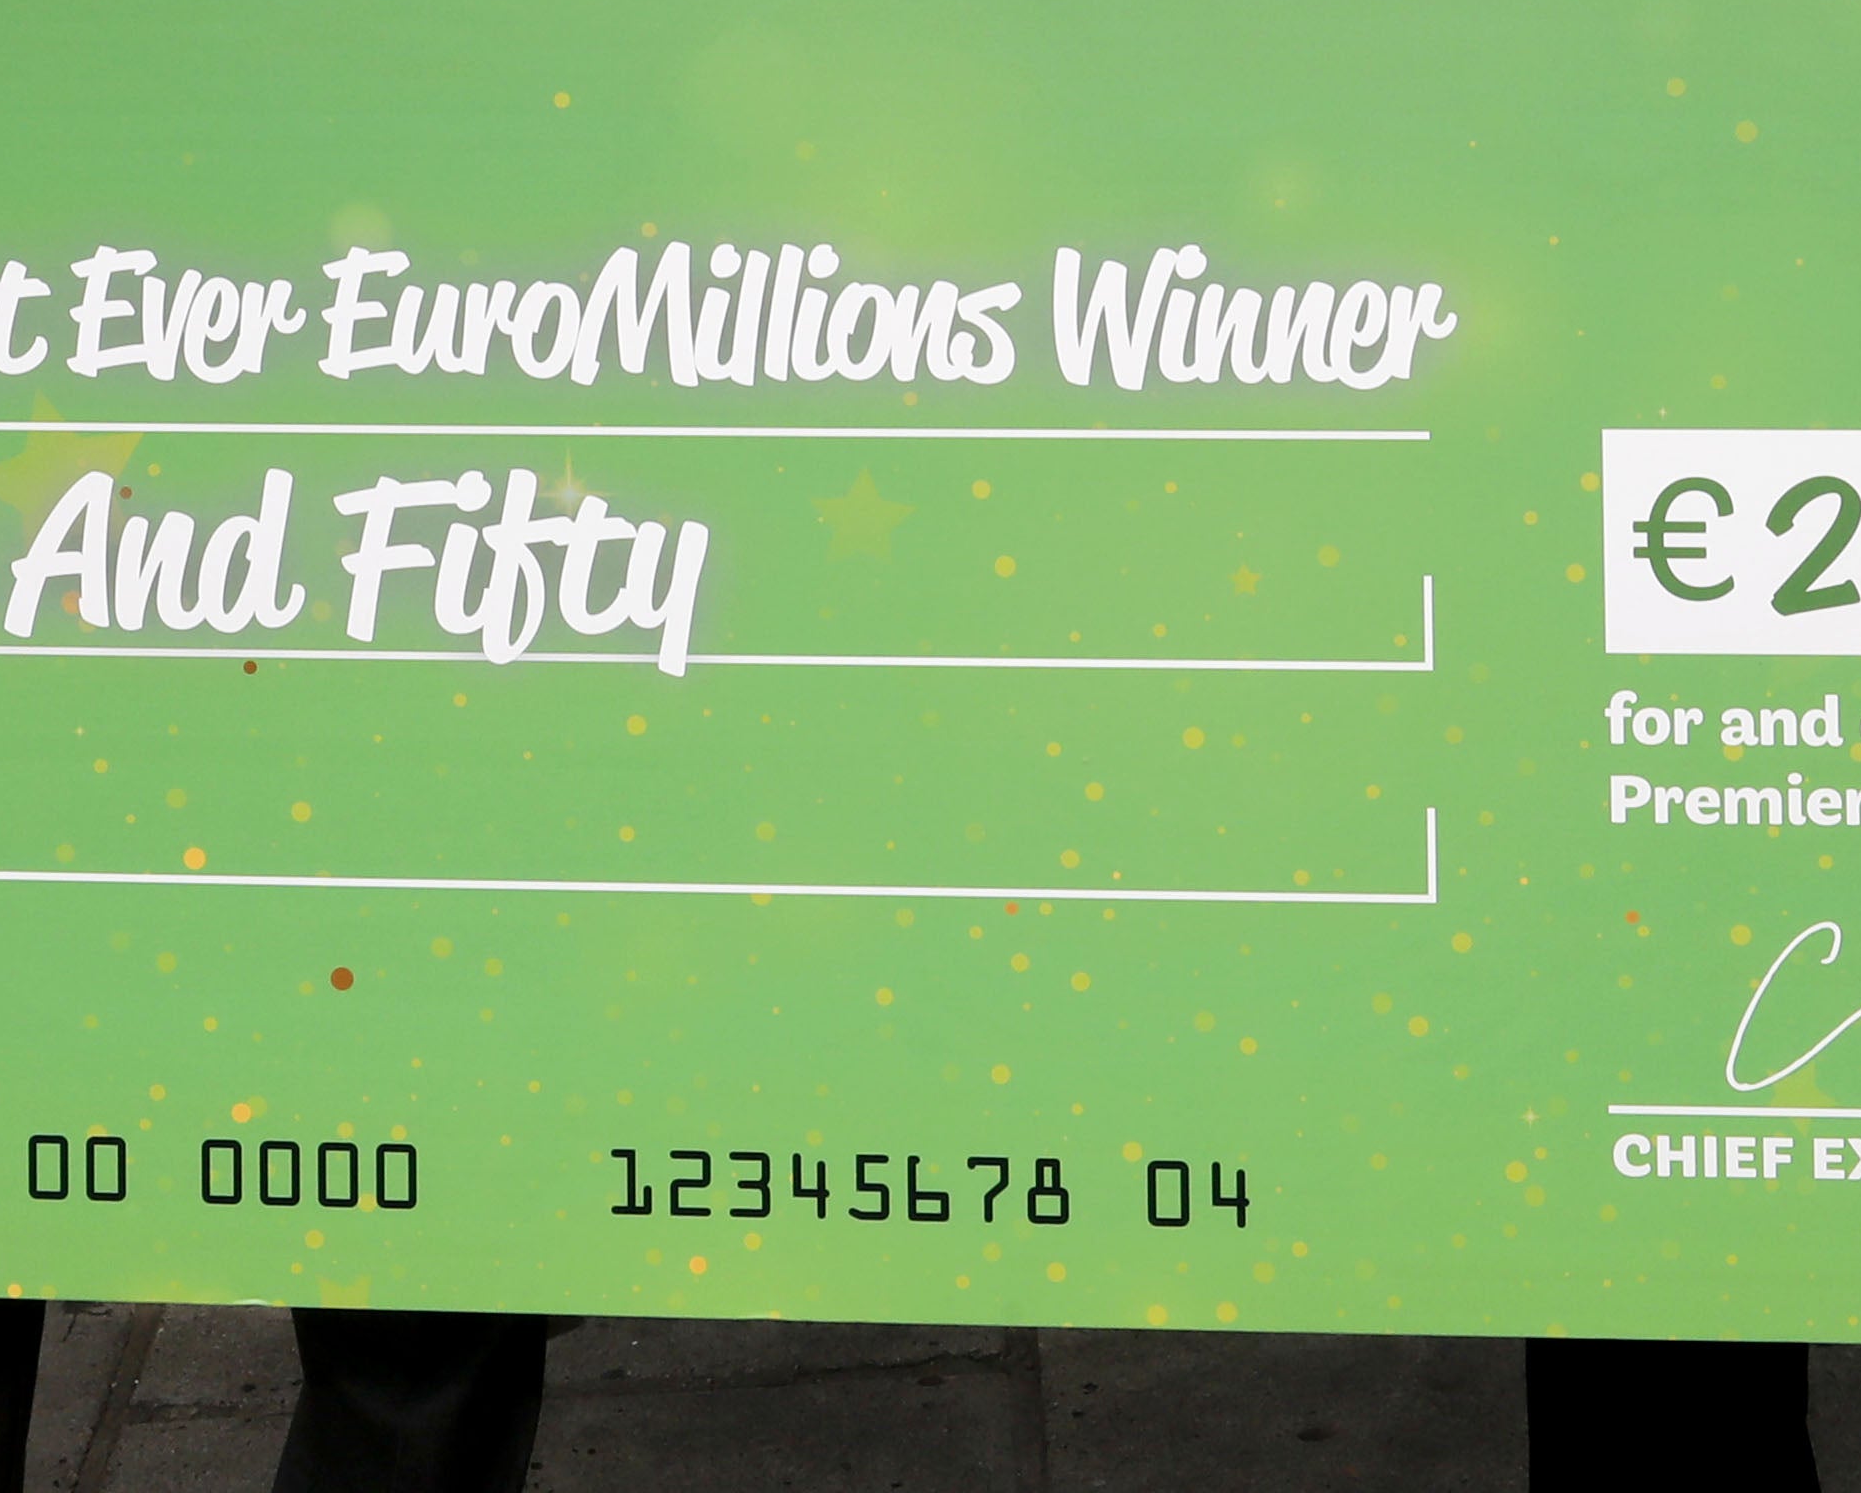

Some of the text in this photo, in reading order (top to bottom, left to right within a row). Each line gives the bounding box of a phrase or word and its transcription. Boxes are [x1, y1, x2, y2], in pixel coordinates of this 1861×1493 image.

[67, 245, 307, 384] Ever
[318, 240, 1023, 387] EuroMillions
[1051, 243, 1459, 392] Winner
[2, 468, 307, 639] And
[332, 468, 711, 678] Fifty
[1604, 689, 1704, 747] for
[1719, 692, 1845, 749] and
[27, 1133, 128, 1203] 00
[200, 1138, 418, 1211] 0000
[610, 1147, 1074, 1226] 12345678
[1146, 1159, 1251, 1229] 04
[1611, 1132, 1795, 1181] CHIEF
